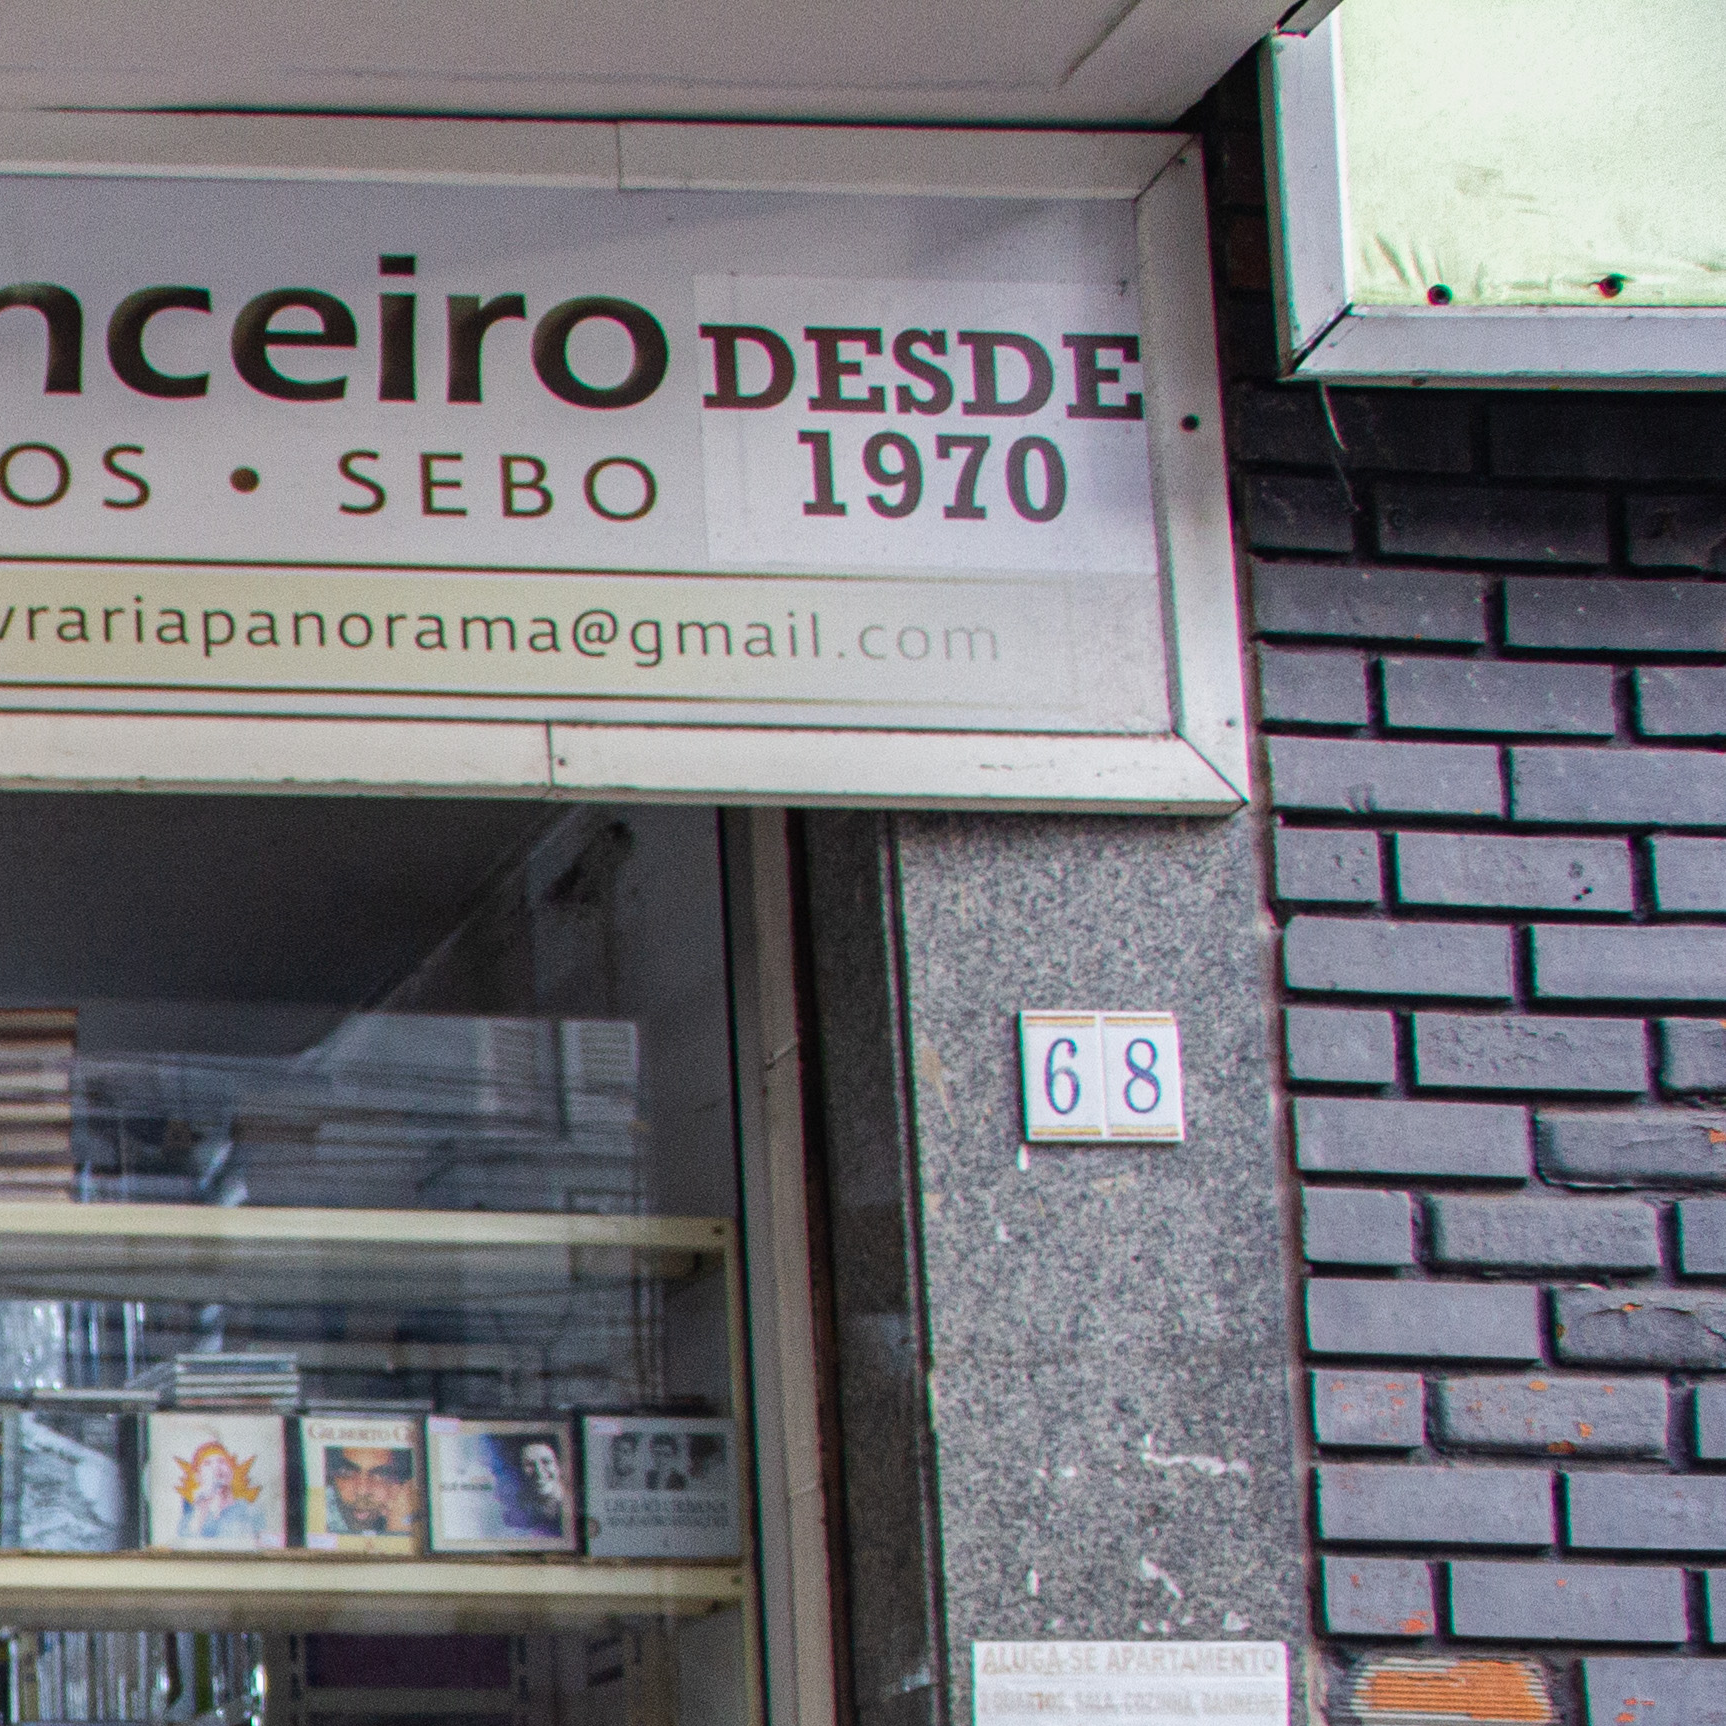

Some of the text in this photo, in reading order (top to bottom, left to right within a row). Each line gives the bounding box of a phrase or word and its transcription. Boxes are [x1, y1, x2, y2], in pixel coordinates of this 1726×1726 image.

[698, 323, 1148, 422] DESDE
[337, 448, 658, 523] SEBO
[797, 429, 1068, 523] 1970
[1044, 1037, 1163, 1116] 68
